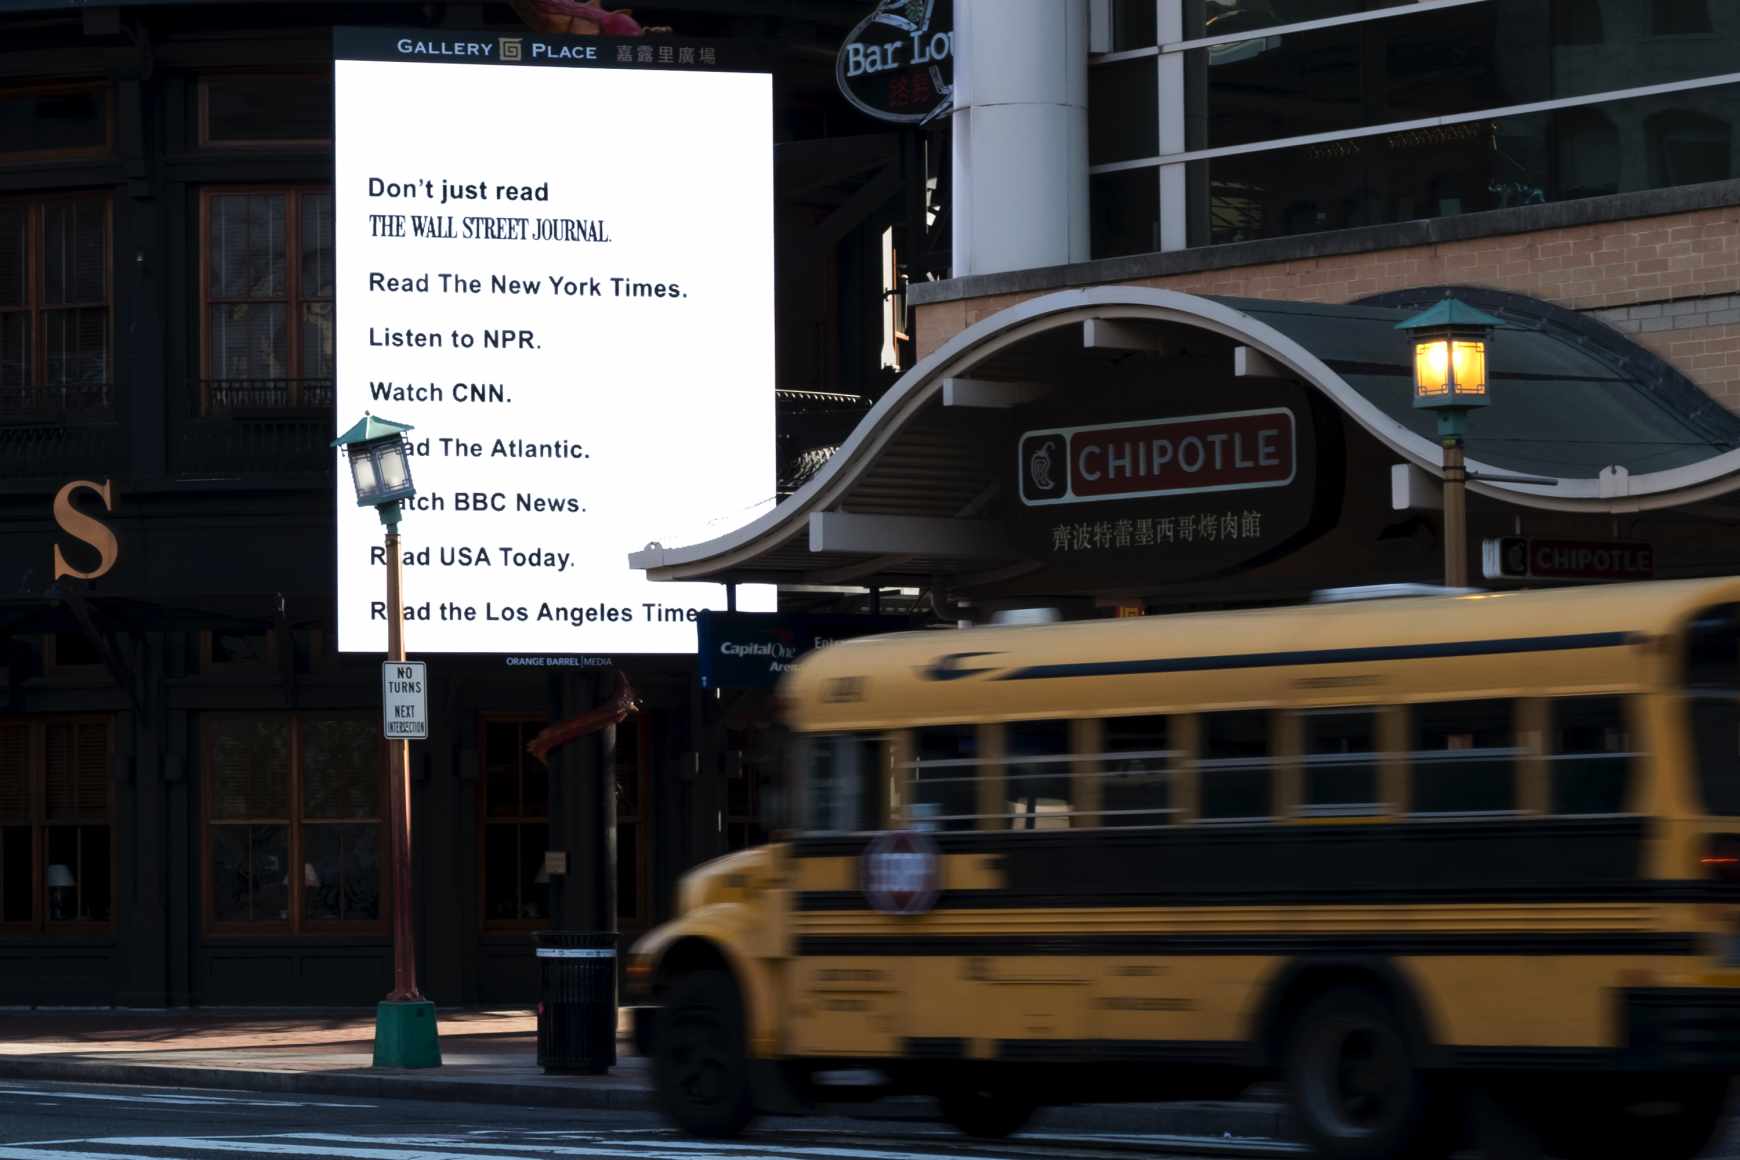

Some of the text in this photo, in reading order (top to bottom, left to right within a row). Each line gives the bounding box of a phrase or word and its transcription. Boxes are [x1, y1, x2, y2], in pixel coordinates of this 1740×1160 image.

[397, 38, 493, 57] GALLERY
[531, 42, 598, 60] PLACE
[847, 41, 903, 77] Bar
[368, 177, 549, 205] Don't just read
[369, 214, 612, 243] THE WALL STREET JOURNAL.
[369, 272, 688, 298] Read The New York Times.
[369, 327, 541, 350] Listen to NPR.
[369, 381, 511, 403] Watch CNN.
[438, 437, 483, 457] The
[490, 438, 590, 459] Atlantic.
[1079, 429, 1281, 481] CHIPOTLE
[454, 492, 506, 512] BBC
[516, 493, 586, 513] News.
[53, 480, 118, 580] S
[370, 546, 575, 571] Rad USA Today.
[1536, 545, 1649, 574] CHIPOTLE
[370, 601, 431, 621] Rad
[439, 601, 477, 622] the
[486, 602, 529, 622] Los
[536, 602, 633, 627] Angeles
[397, 667, 413, 679] NO
[505, 656, 613, 667] ORANGE BARREL MEDIA
[388, 681, 422, 694] TURNS
[394, 704, 415, 719] NEXT
